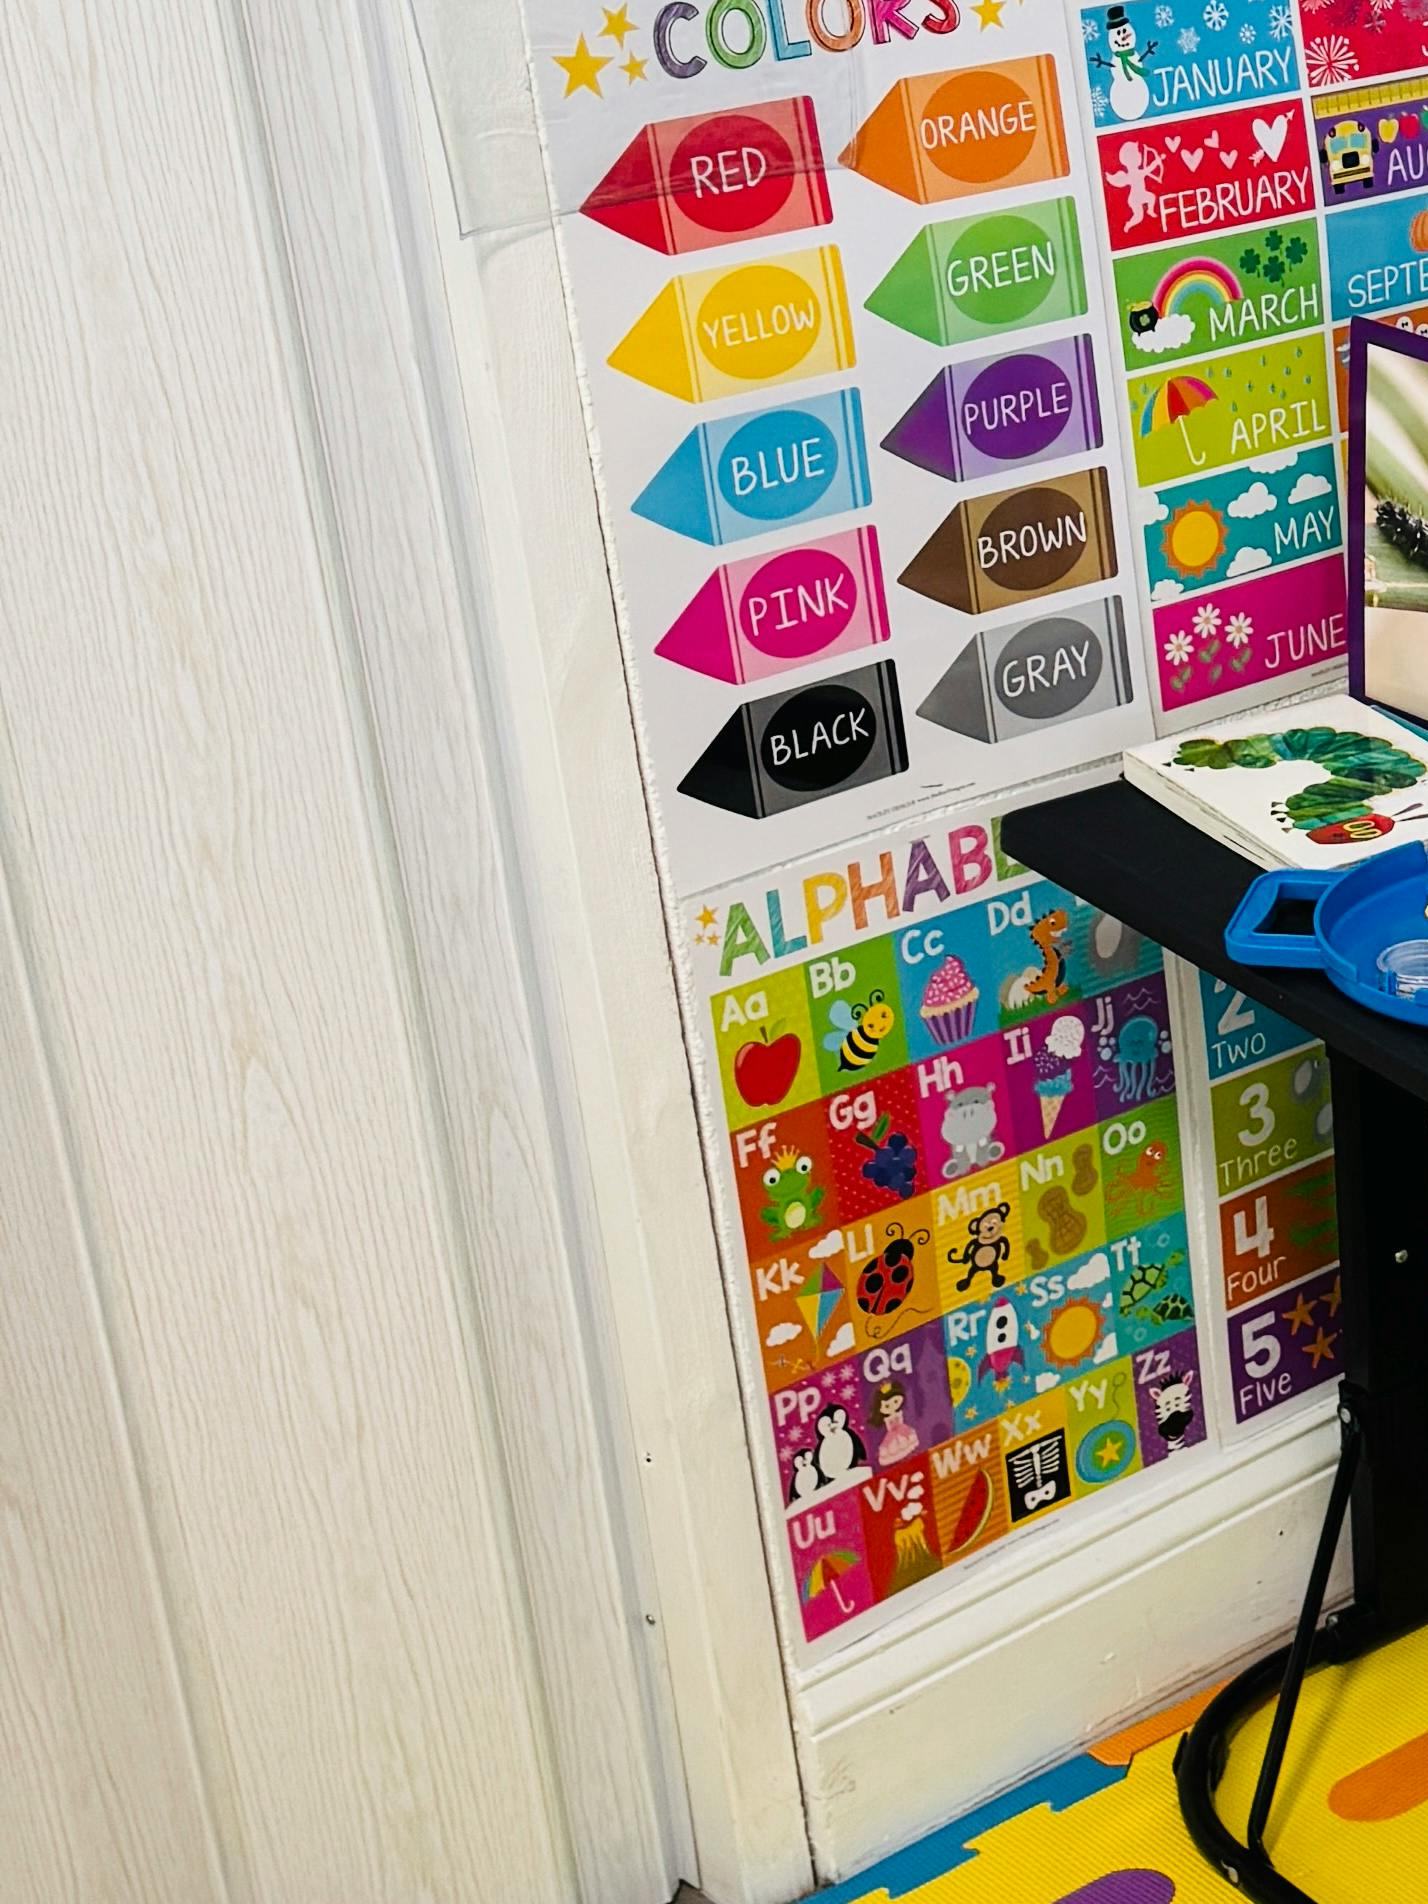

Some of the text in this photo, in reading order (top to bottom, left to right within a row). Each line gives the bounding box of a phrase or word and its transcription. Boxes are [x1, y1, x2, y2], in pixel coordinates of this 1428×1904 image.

[1152, 47, 1292, 108] JANUARY
[920, 101, 1037, 151] ORANGE
[688, 146, 766, 199] RED
[1159, 167, 1310, 234] FEBRUARY
[946, 240, 1056, 298] GREEN
[702, 300, 815, 350] YELLOW
[1209, 282, 1319, 342] MARCH
[963, 382, 1070, 436] PURPLE
[1230, 398, 1326, 454] APRIL
[730, 437, 826, 496] BLUE
[976, 511, 1088, 570] BROWN
[1274, 505, 1336, 555] MAY
[747, 573, 849, 637] PINK
[1002, 640, 1091, 697] GRAY
[1265, 612, 1347, 670] JUNE
[770, 708, 869, 766] BLACK
[987, 892, 1033, 936] Dd
[900, 926, 945, 965] Cc
[808, 958, 857, 998] Bb
[719, 992, 769, 1032] Aa
[1211, 1031, 1267, 1070] Two
[1236, 1081, 1276, 1147] 3
[1218, 1135, 1298, 1189] Three
[1226, 1253, 1288, 1302] Four
